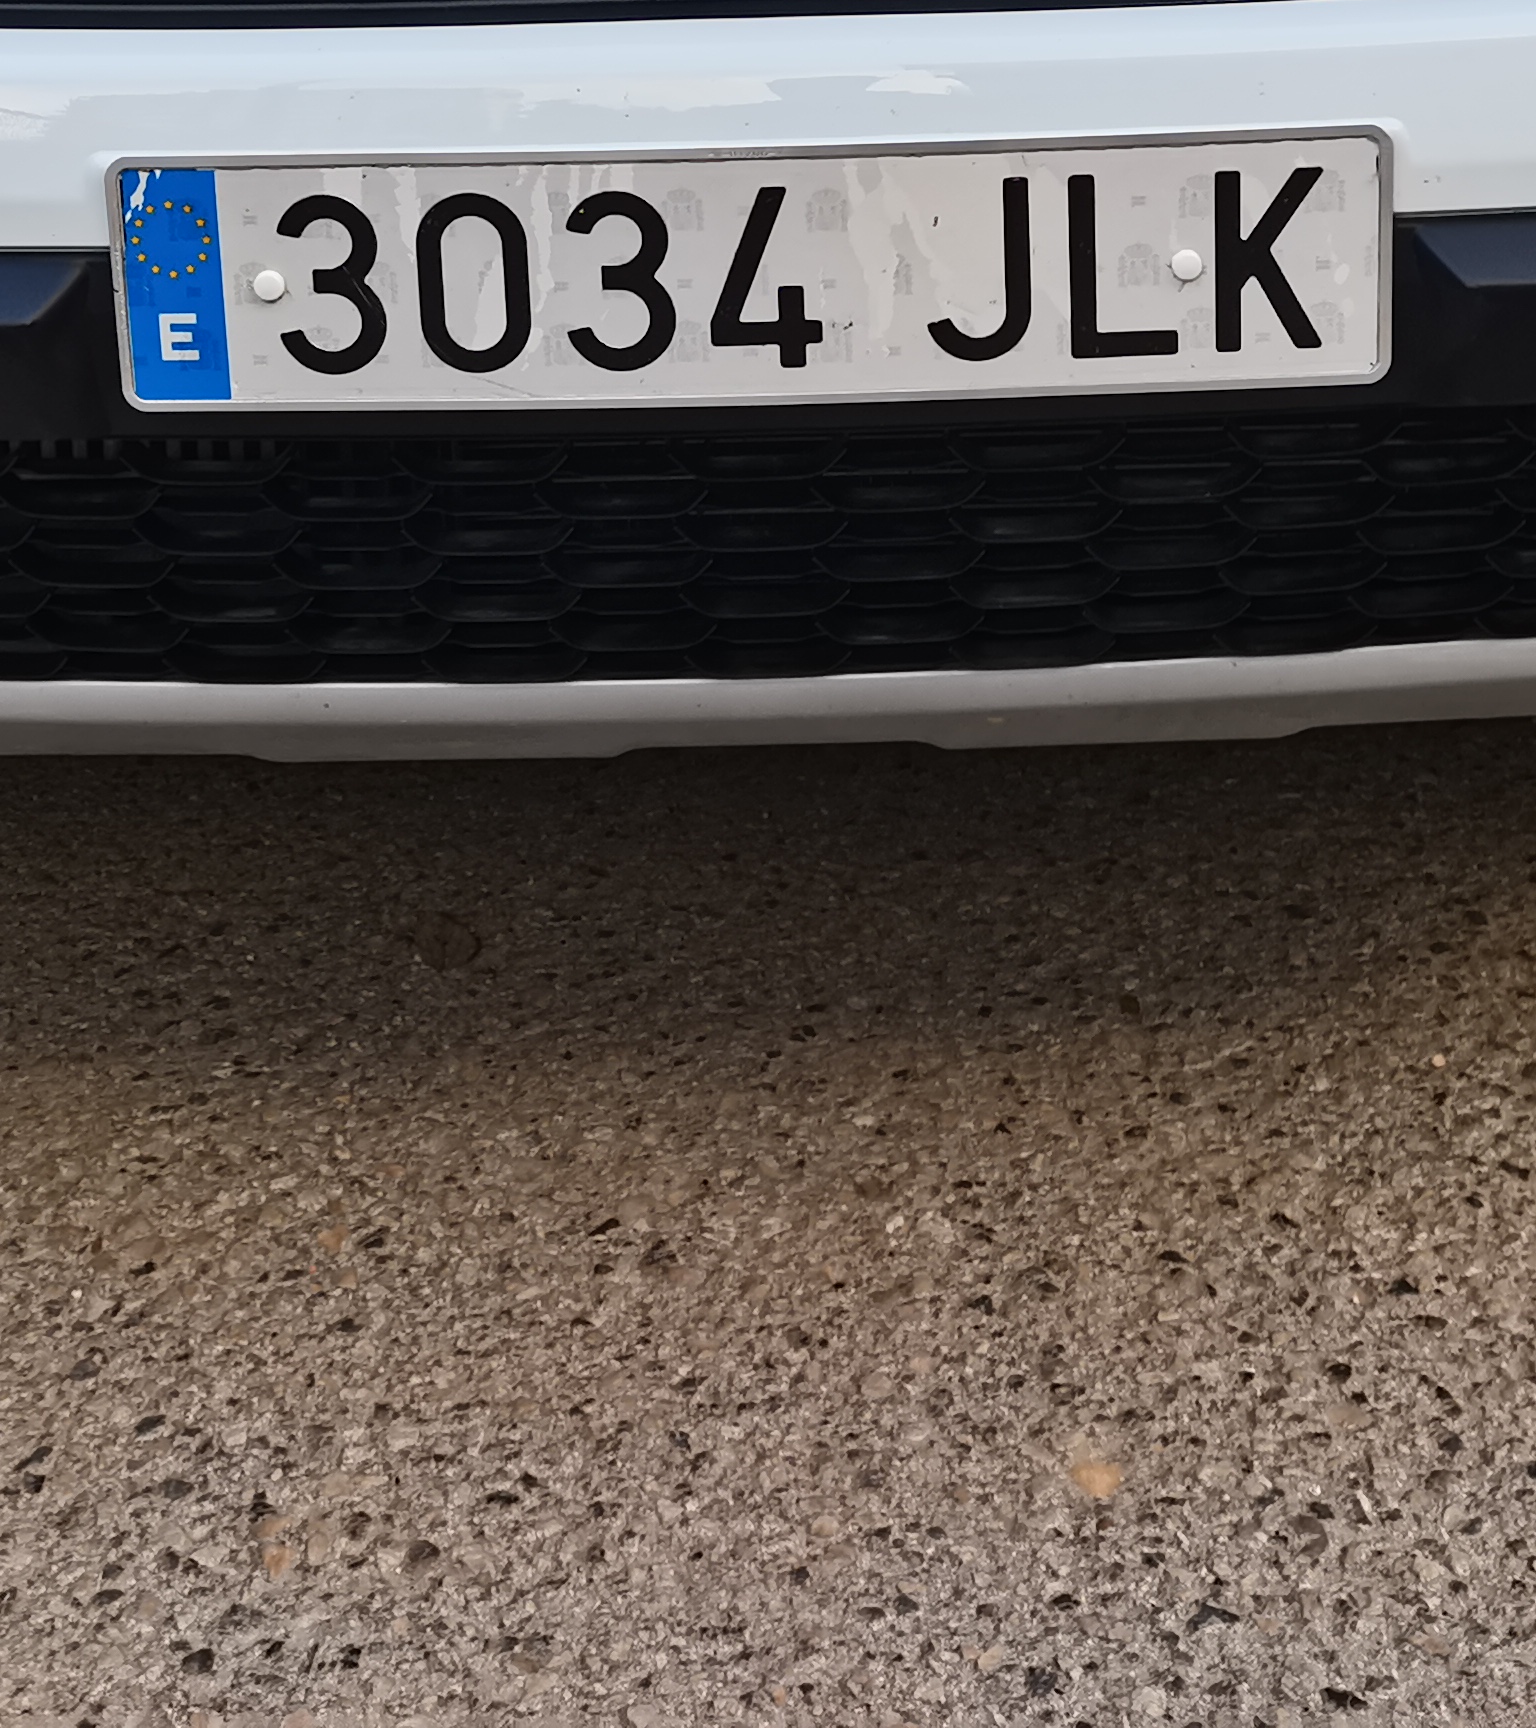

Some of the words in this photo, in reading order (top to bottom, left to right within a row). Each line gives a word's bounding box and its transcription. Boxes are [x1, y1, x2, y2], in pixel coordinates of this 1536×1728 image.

[276, 186, 824, 375] 3034
[927, 167, 1324, 362] JLK
[159, 313, 200, 361] E
